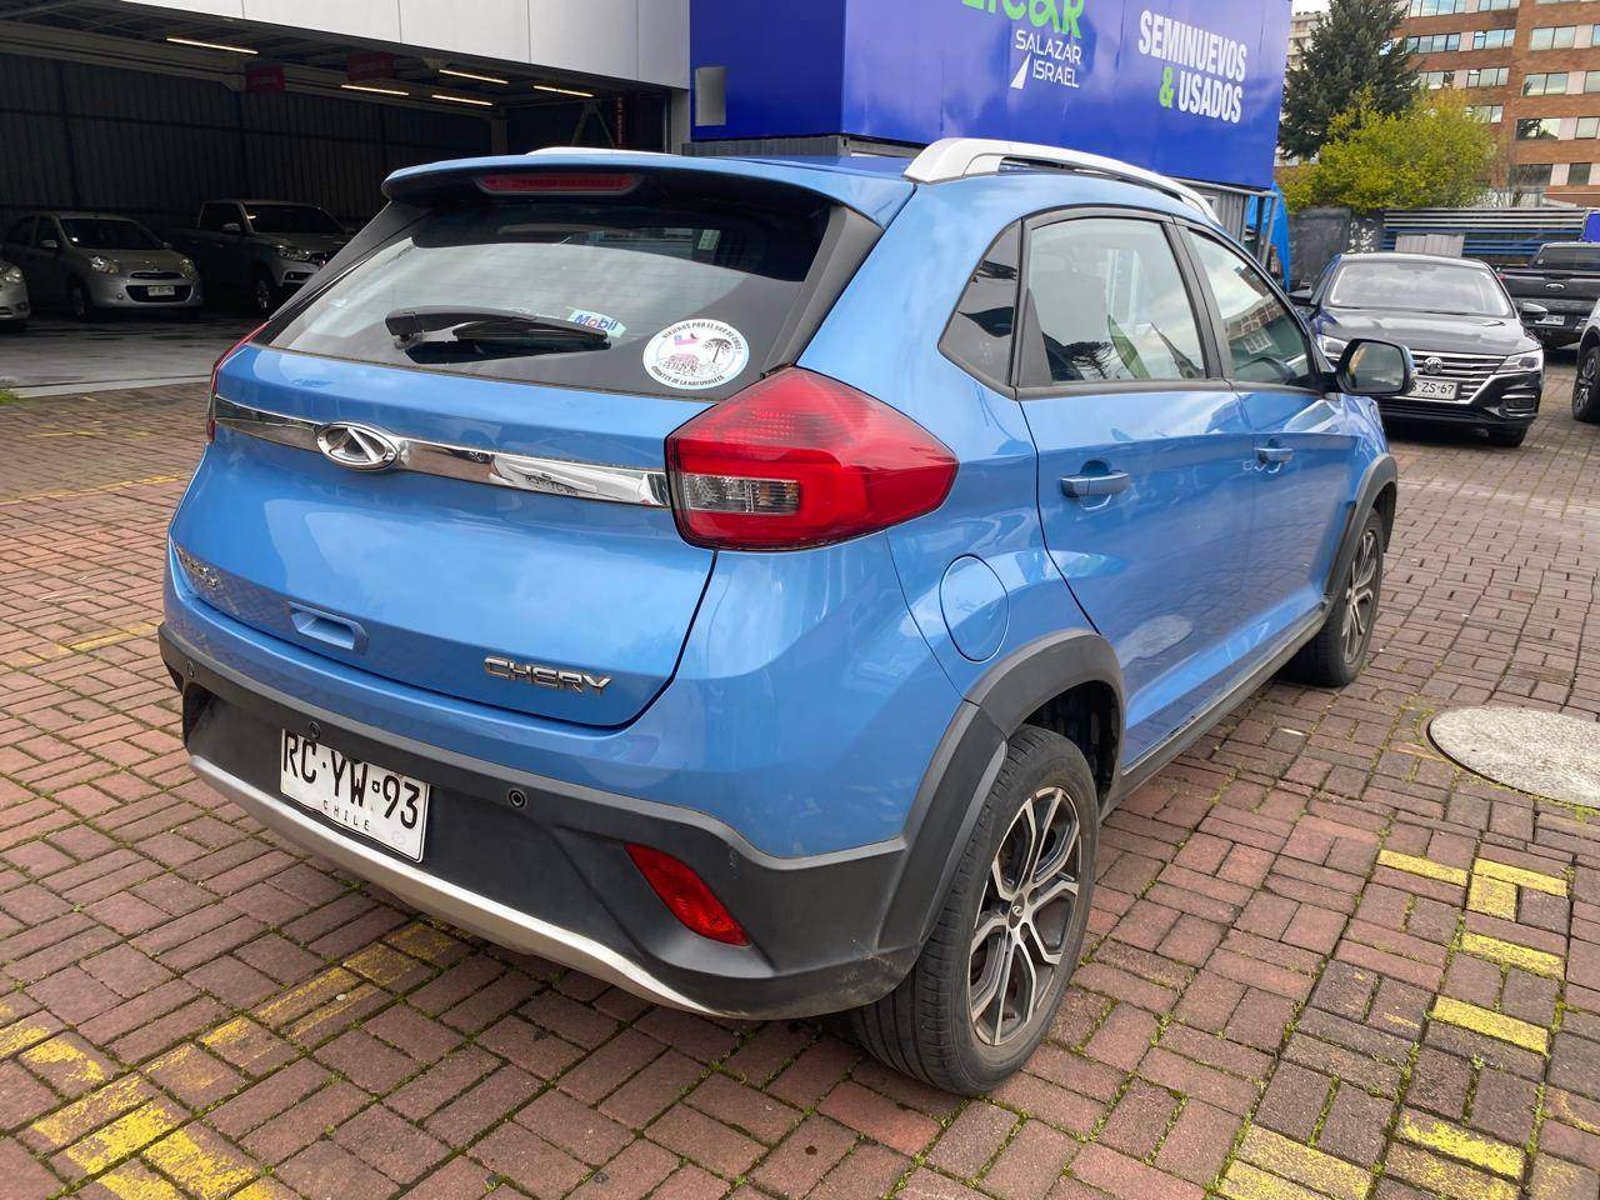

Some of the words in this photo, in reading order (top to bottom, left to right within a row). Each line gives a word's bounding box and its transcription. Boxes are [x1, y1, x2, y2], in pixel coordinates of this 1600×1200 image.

[1015, 29, 1082, 66] SALAZAR
[1139, 9, 1247, 82] SEMINUEVOS
[1032, 59, 1080, 88] ISRAEL
[1159, 66, 1175, 109] &
[1178, 70, 1243, 123] USADOS
[574, 314, 618, 331] Mobil
[692, 321, 706, 330] POR
[484, 656, 612, 695] CHERY
[323, 799, 371, 831] CHILE
